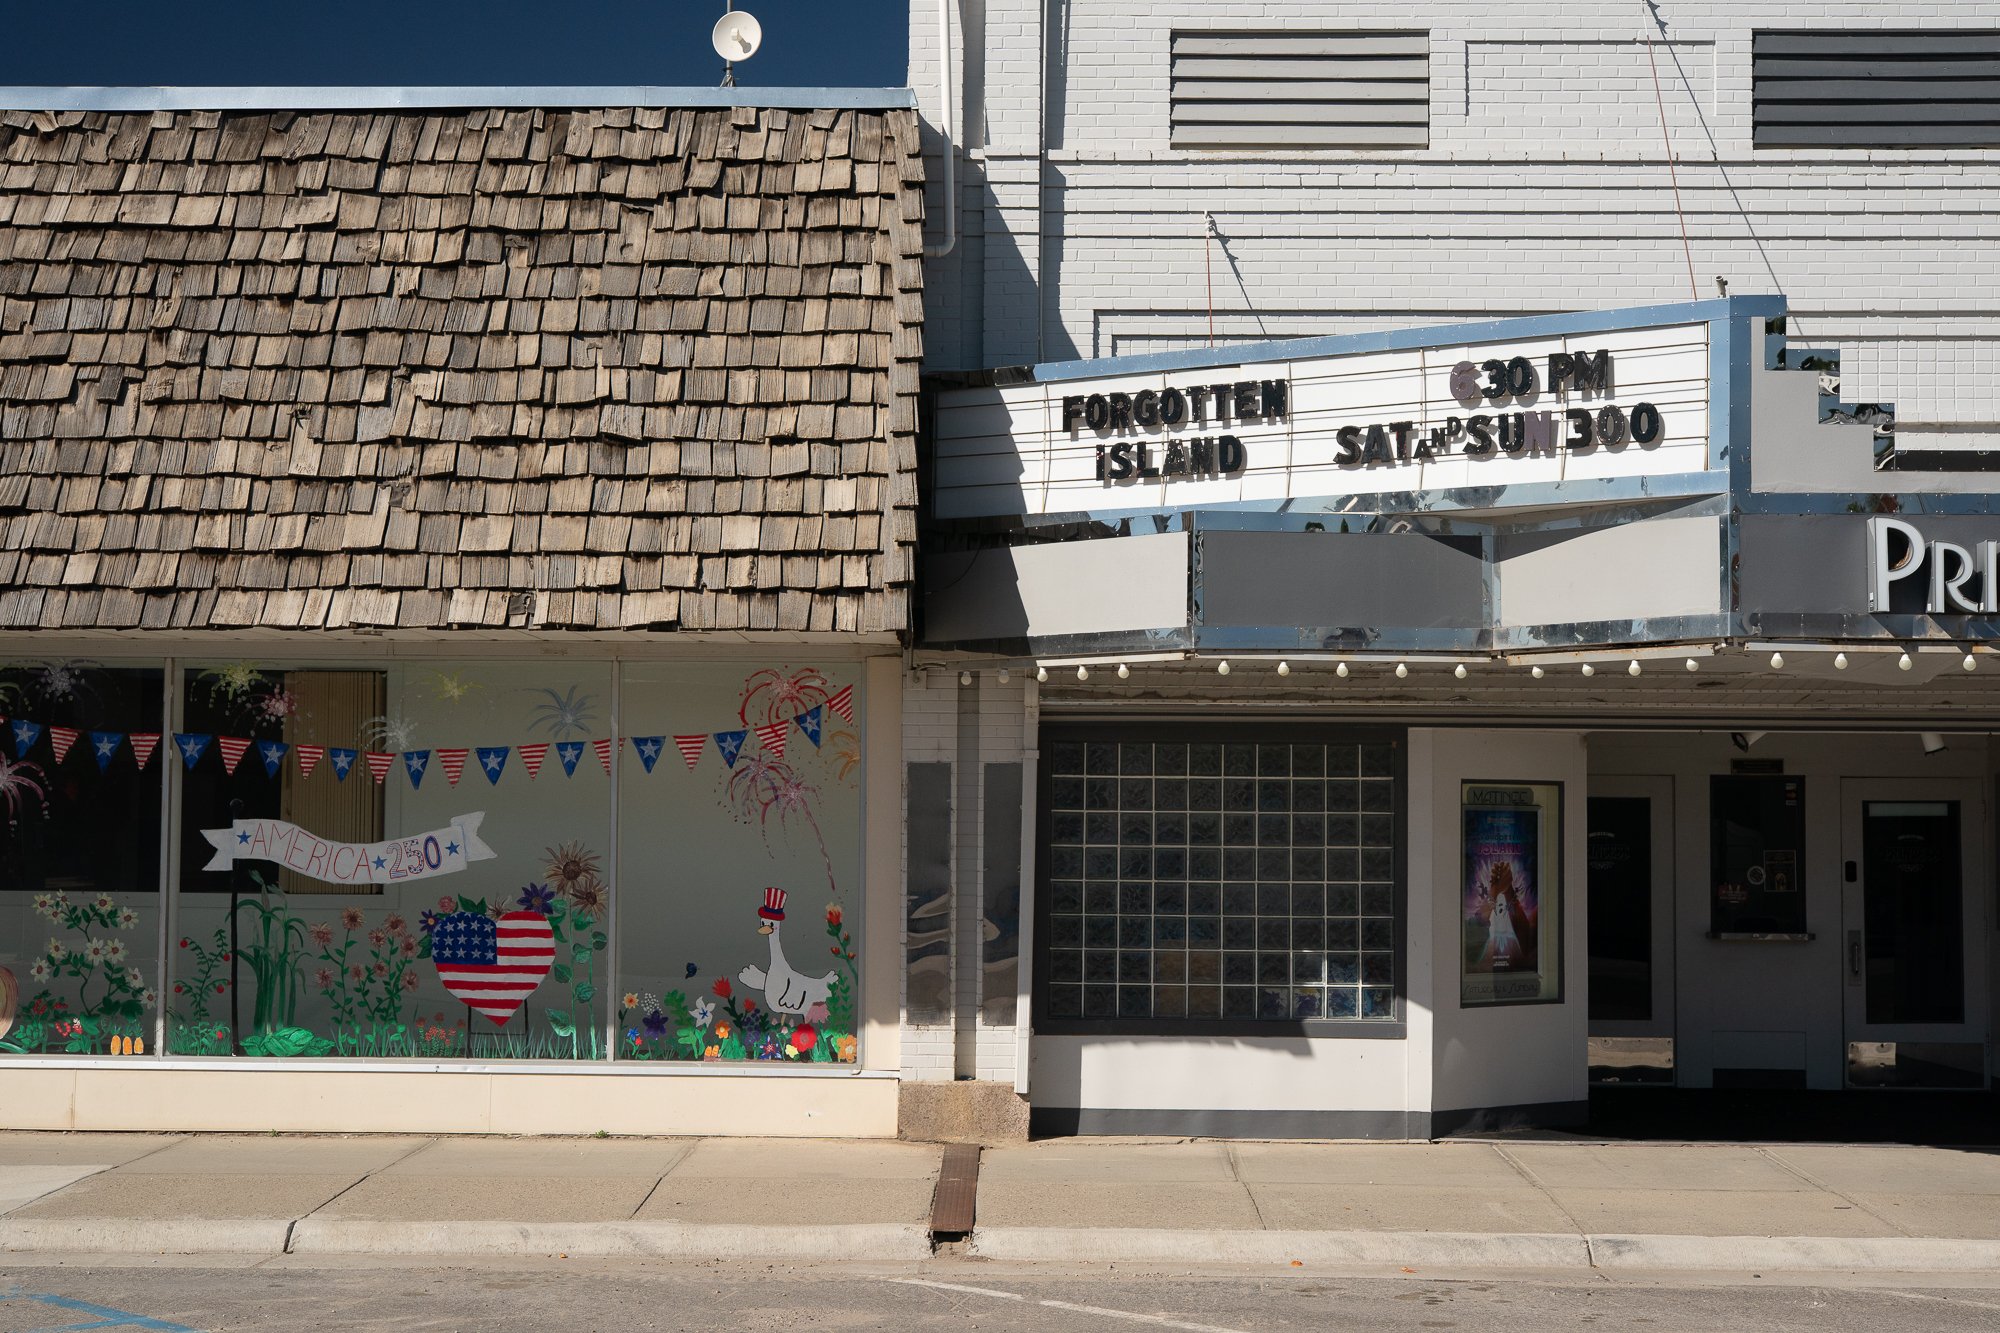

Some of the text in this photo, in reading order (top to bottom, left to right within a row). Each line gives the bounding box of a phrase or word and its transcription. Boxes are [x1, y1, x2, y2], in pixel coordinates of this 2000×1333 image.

[1450, 350, 1608, 400] 630 PM
[1063, 379, 1286, 432] FORGOTTEN
[1334, 420, 1413, 464] SAT
[1463, 410, 1552, 454] SUN
[1566, 402, 1658, 450] 300
[1096, 434, 1242, 481] ISLAND
[1867, 515, 2000, 613] PRI
[250, 823, 441, 880] AMERICA 250
